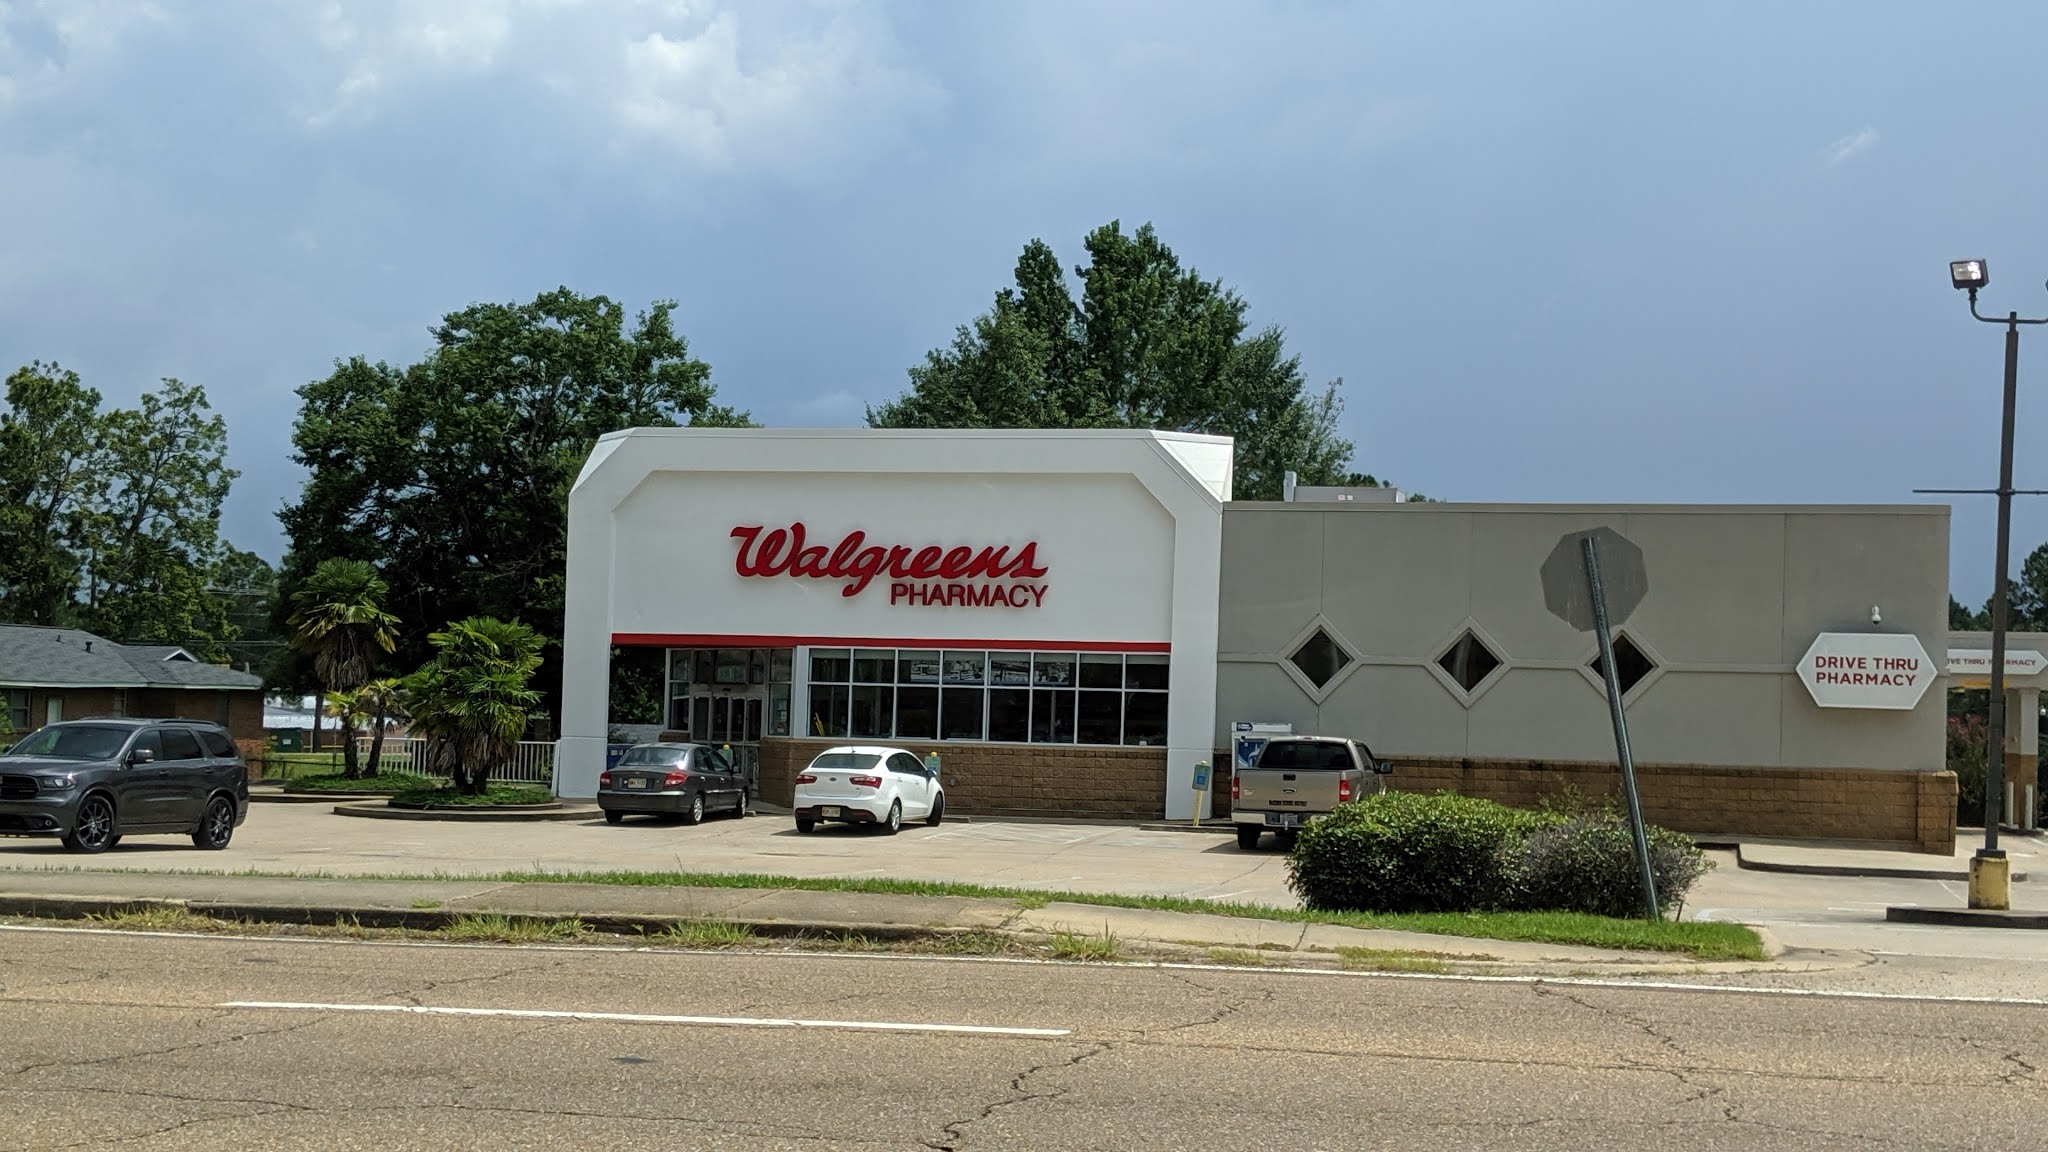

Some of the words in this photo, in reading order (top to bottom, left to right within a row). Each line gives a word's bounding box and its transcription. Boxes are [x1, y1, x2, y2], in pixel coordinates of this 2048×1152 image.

[730, 522, 1049, 598] Walgreens
[890, 583, 1049, 608] PHARMACY
[1815, 656, 1867, 669] DRIVE
[1873, 657, 1919, 671] THRU
[1964, 658, 1985, 666] THRU
[1815, 671, 1917, 686] PHARMACY
